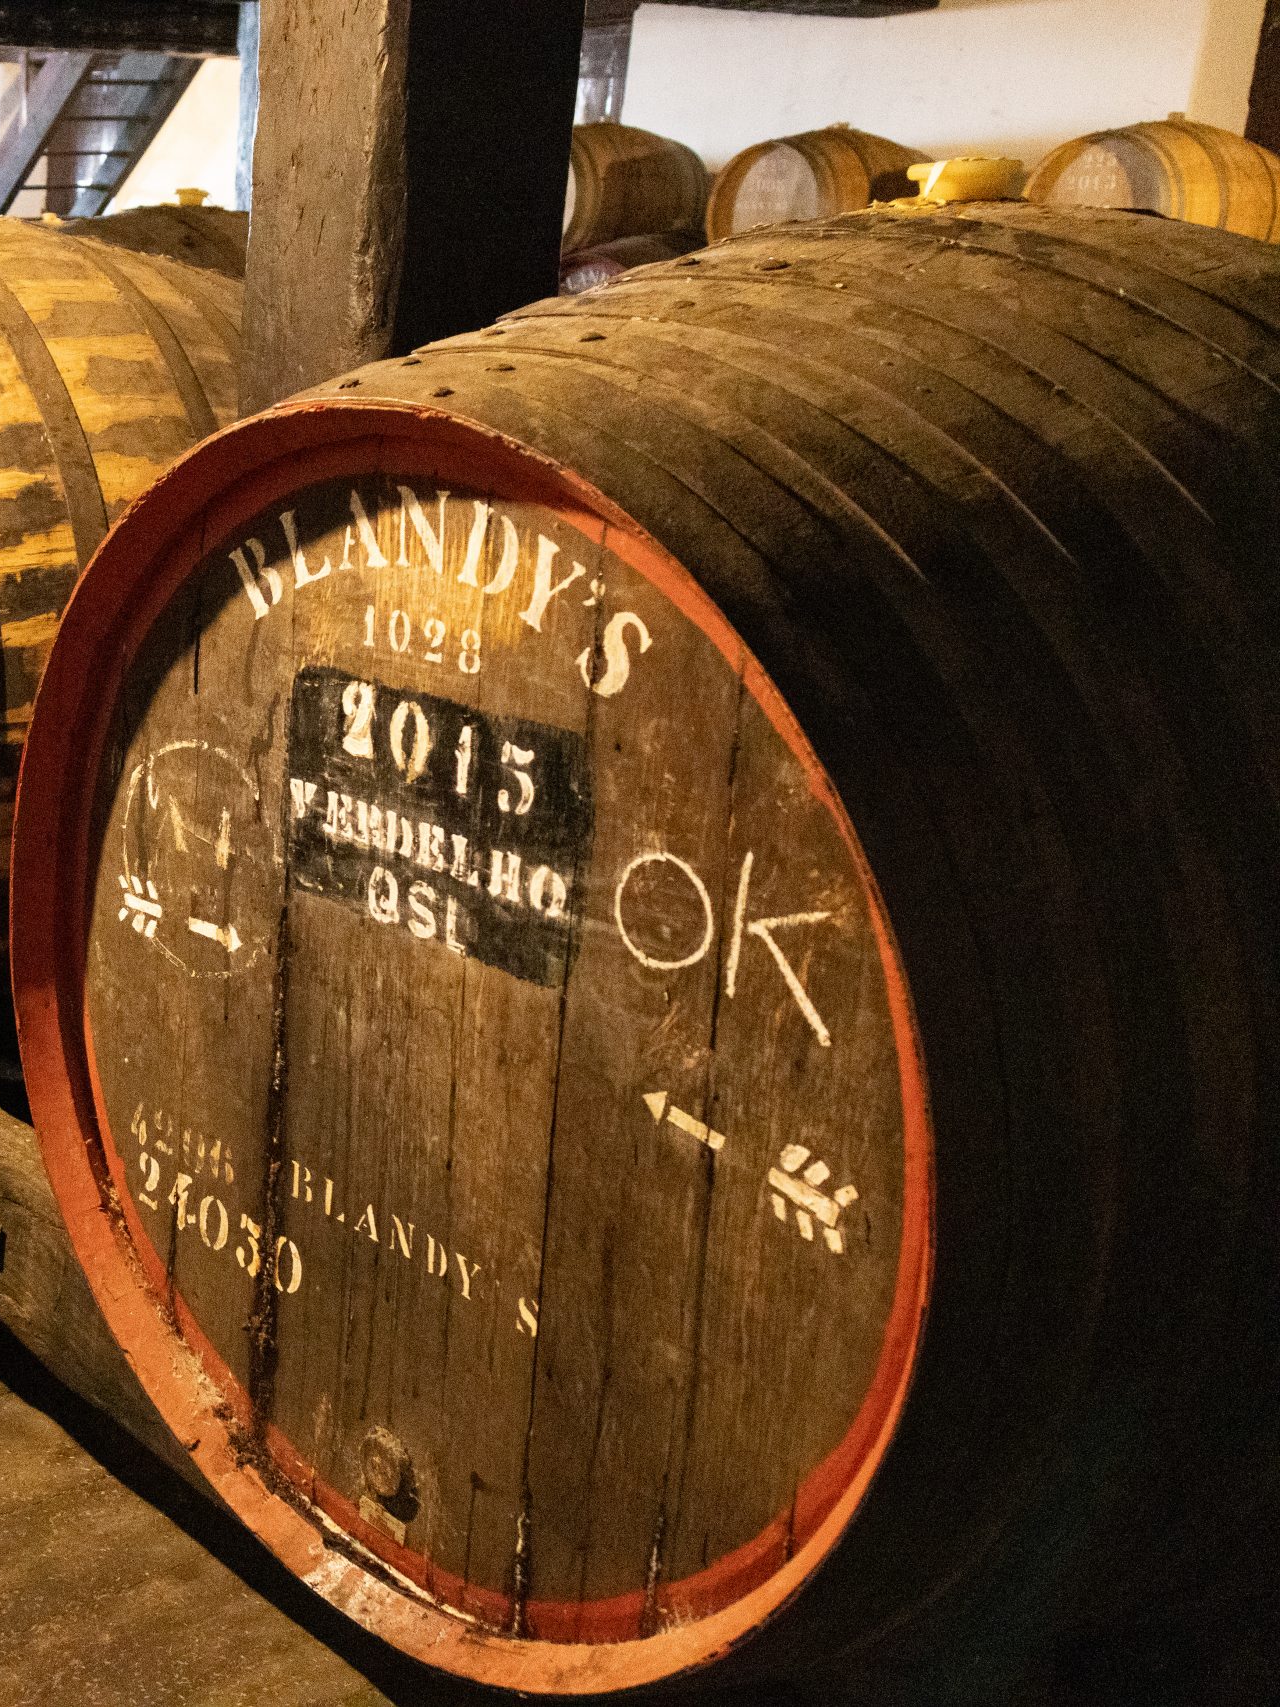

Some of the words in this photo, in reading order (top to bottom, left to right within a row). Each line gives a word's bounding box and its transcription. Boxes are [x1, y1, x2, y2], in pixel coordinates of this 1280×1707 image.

[228, 485, 653, 697] BLANDY'S
[363, 605, 482, 675] 1028
[341, 680, 536, 815] 2015
[289, 777, 568, 919] VERDELHO
